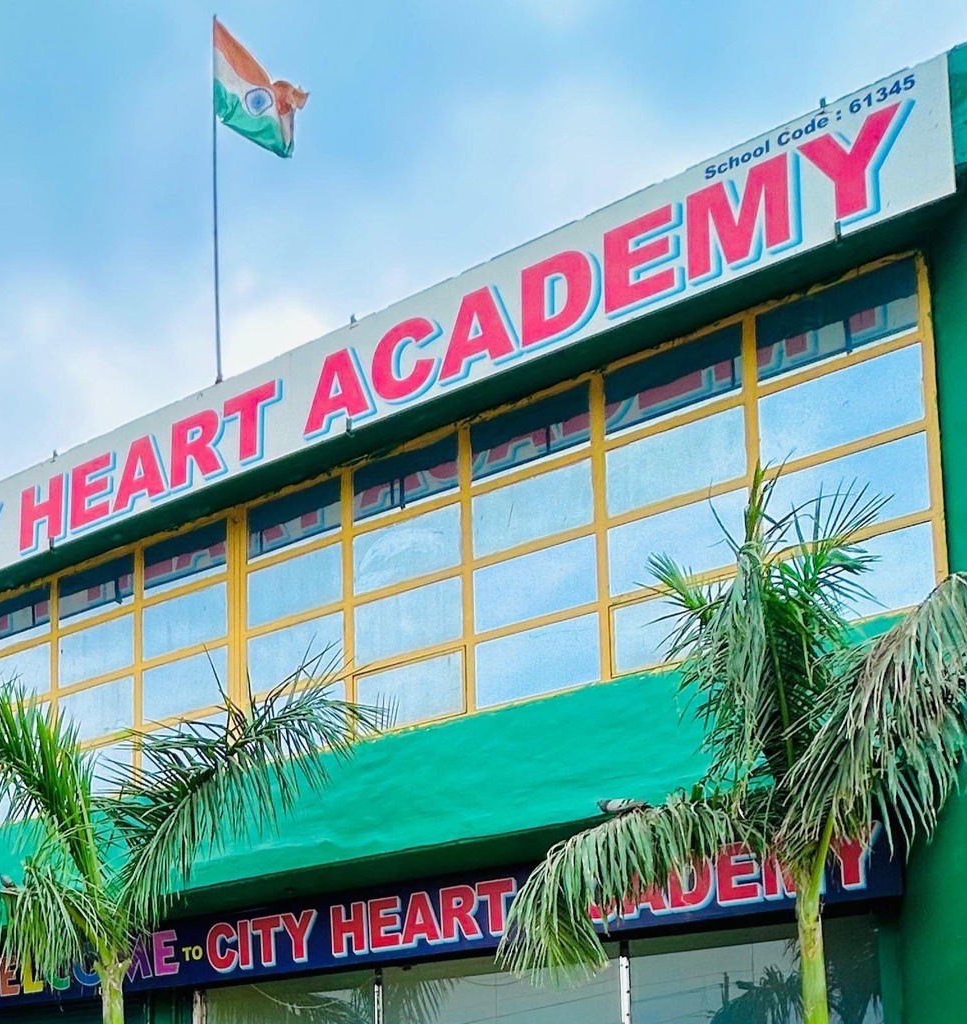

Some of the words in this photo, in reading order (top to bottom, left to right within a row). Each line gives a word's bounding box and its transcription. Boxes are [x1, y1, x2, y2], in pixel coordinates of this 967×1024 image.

[704, 139, 770, 180] School
[777, 115, 830, 147] Code
[848, 73, 917, 115] 61345
[19, 382, 282, 556] HEART
[303, 99, 915, 440] ACADEMY
[181, 945, 203, 962] TO
[206, 908, 318, 974] CITY
[330, 875, 518, 959] HEART
